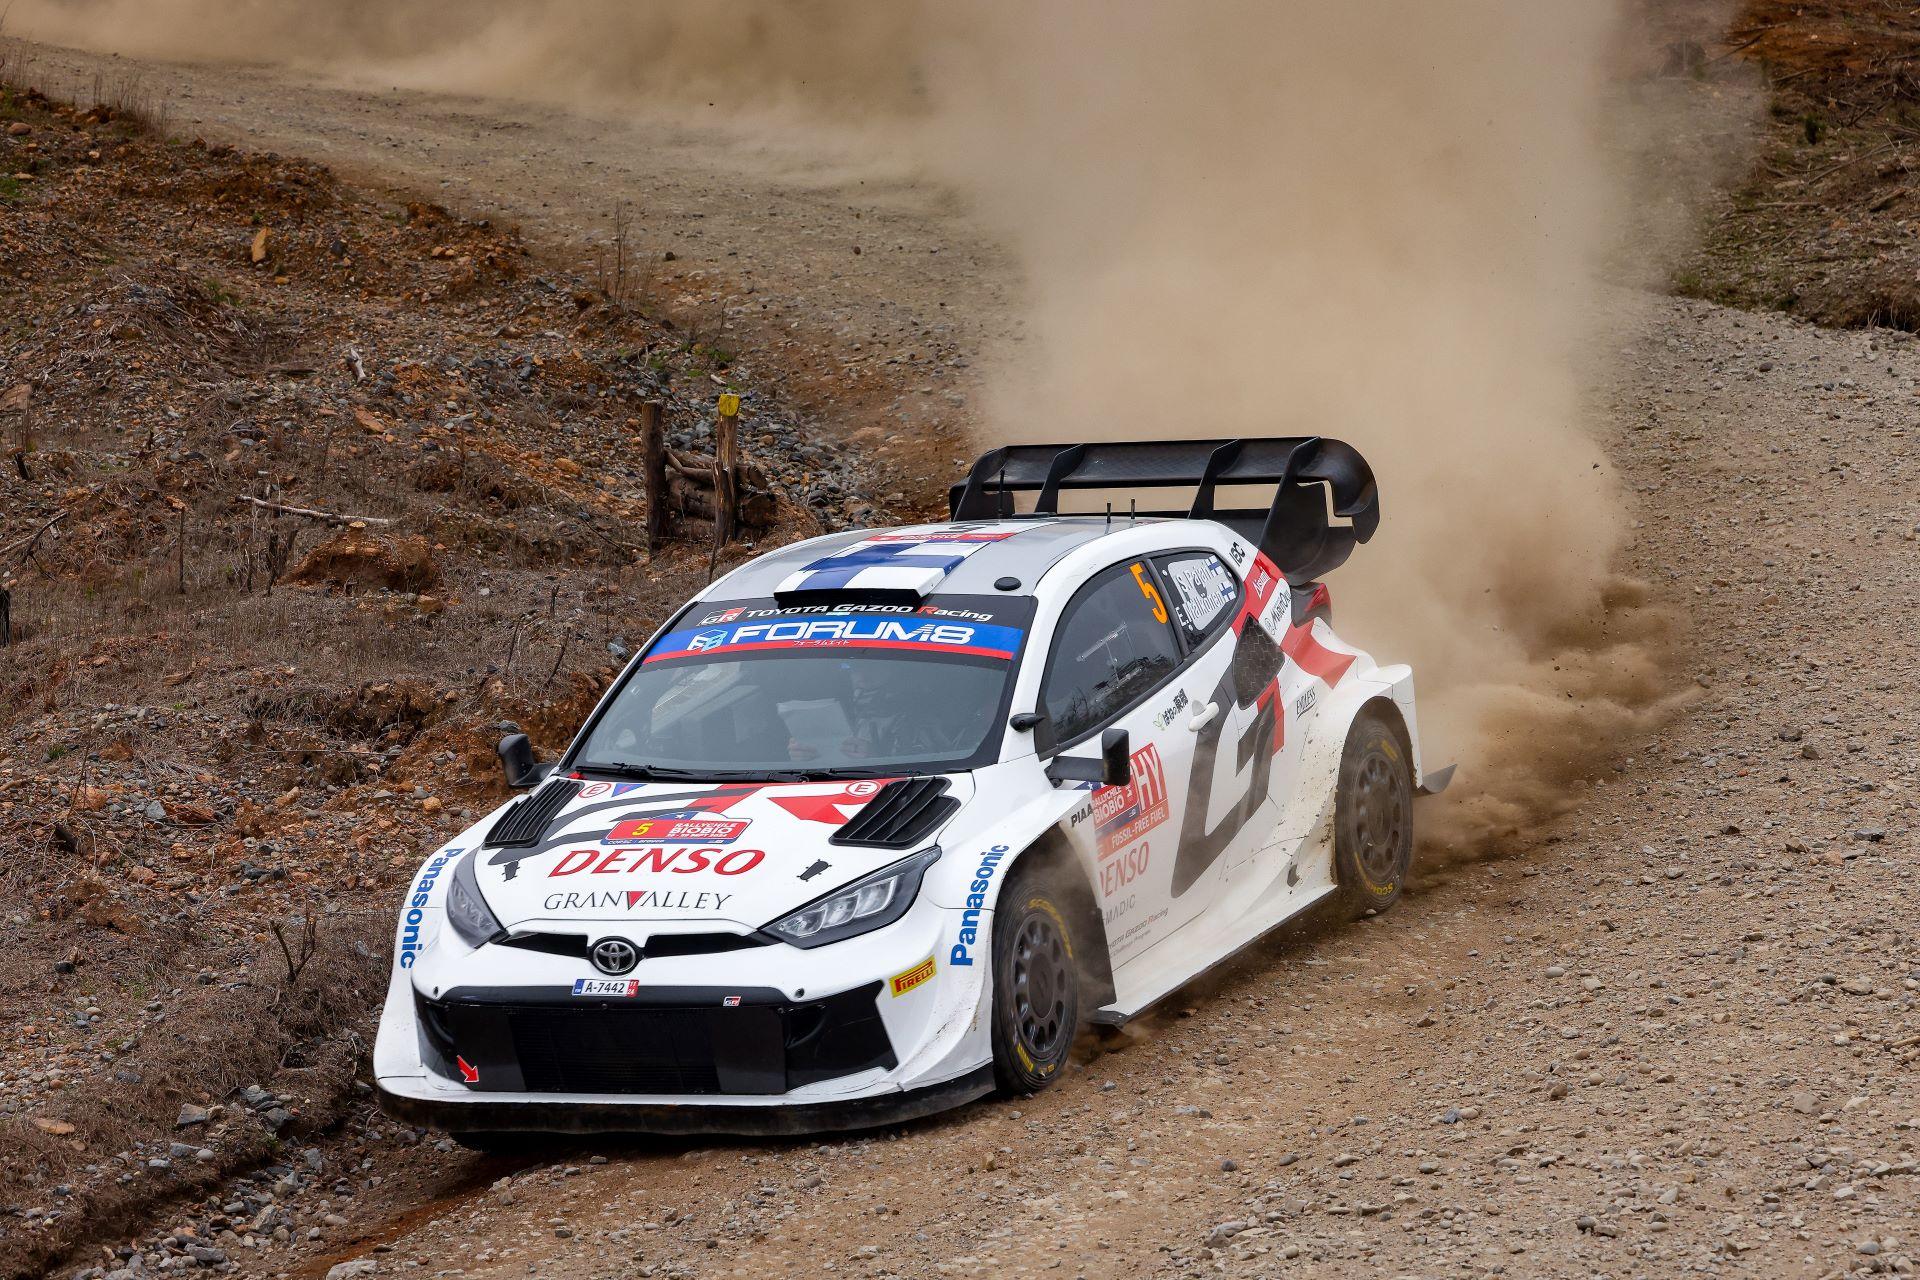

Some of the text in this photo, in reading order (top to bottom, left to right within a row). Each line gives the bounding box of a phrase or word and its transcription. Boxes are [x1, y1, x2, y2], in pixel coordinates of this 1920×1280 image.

[1130, 562, 1168, 624] 5
[747, 605, 828, 618] TOYOTA
[832, 603, 913, 613] GAZOO
[917, 605, 994, 622] Racing
[730, 620, 975, 645] FORUM8
[631, 822, 655, 836] 5
[547, 847, 765, 878] DENSO
[400, 847, 466, 969] Panasonic
[950, 844, 1010, 967] Panasonic
[585, 981, 625, 993] A-7442
[894, 960, 934, 992] PIRELLI
